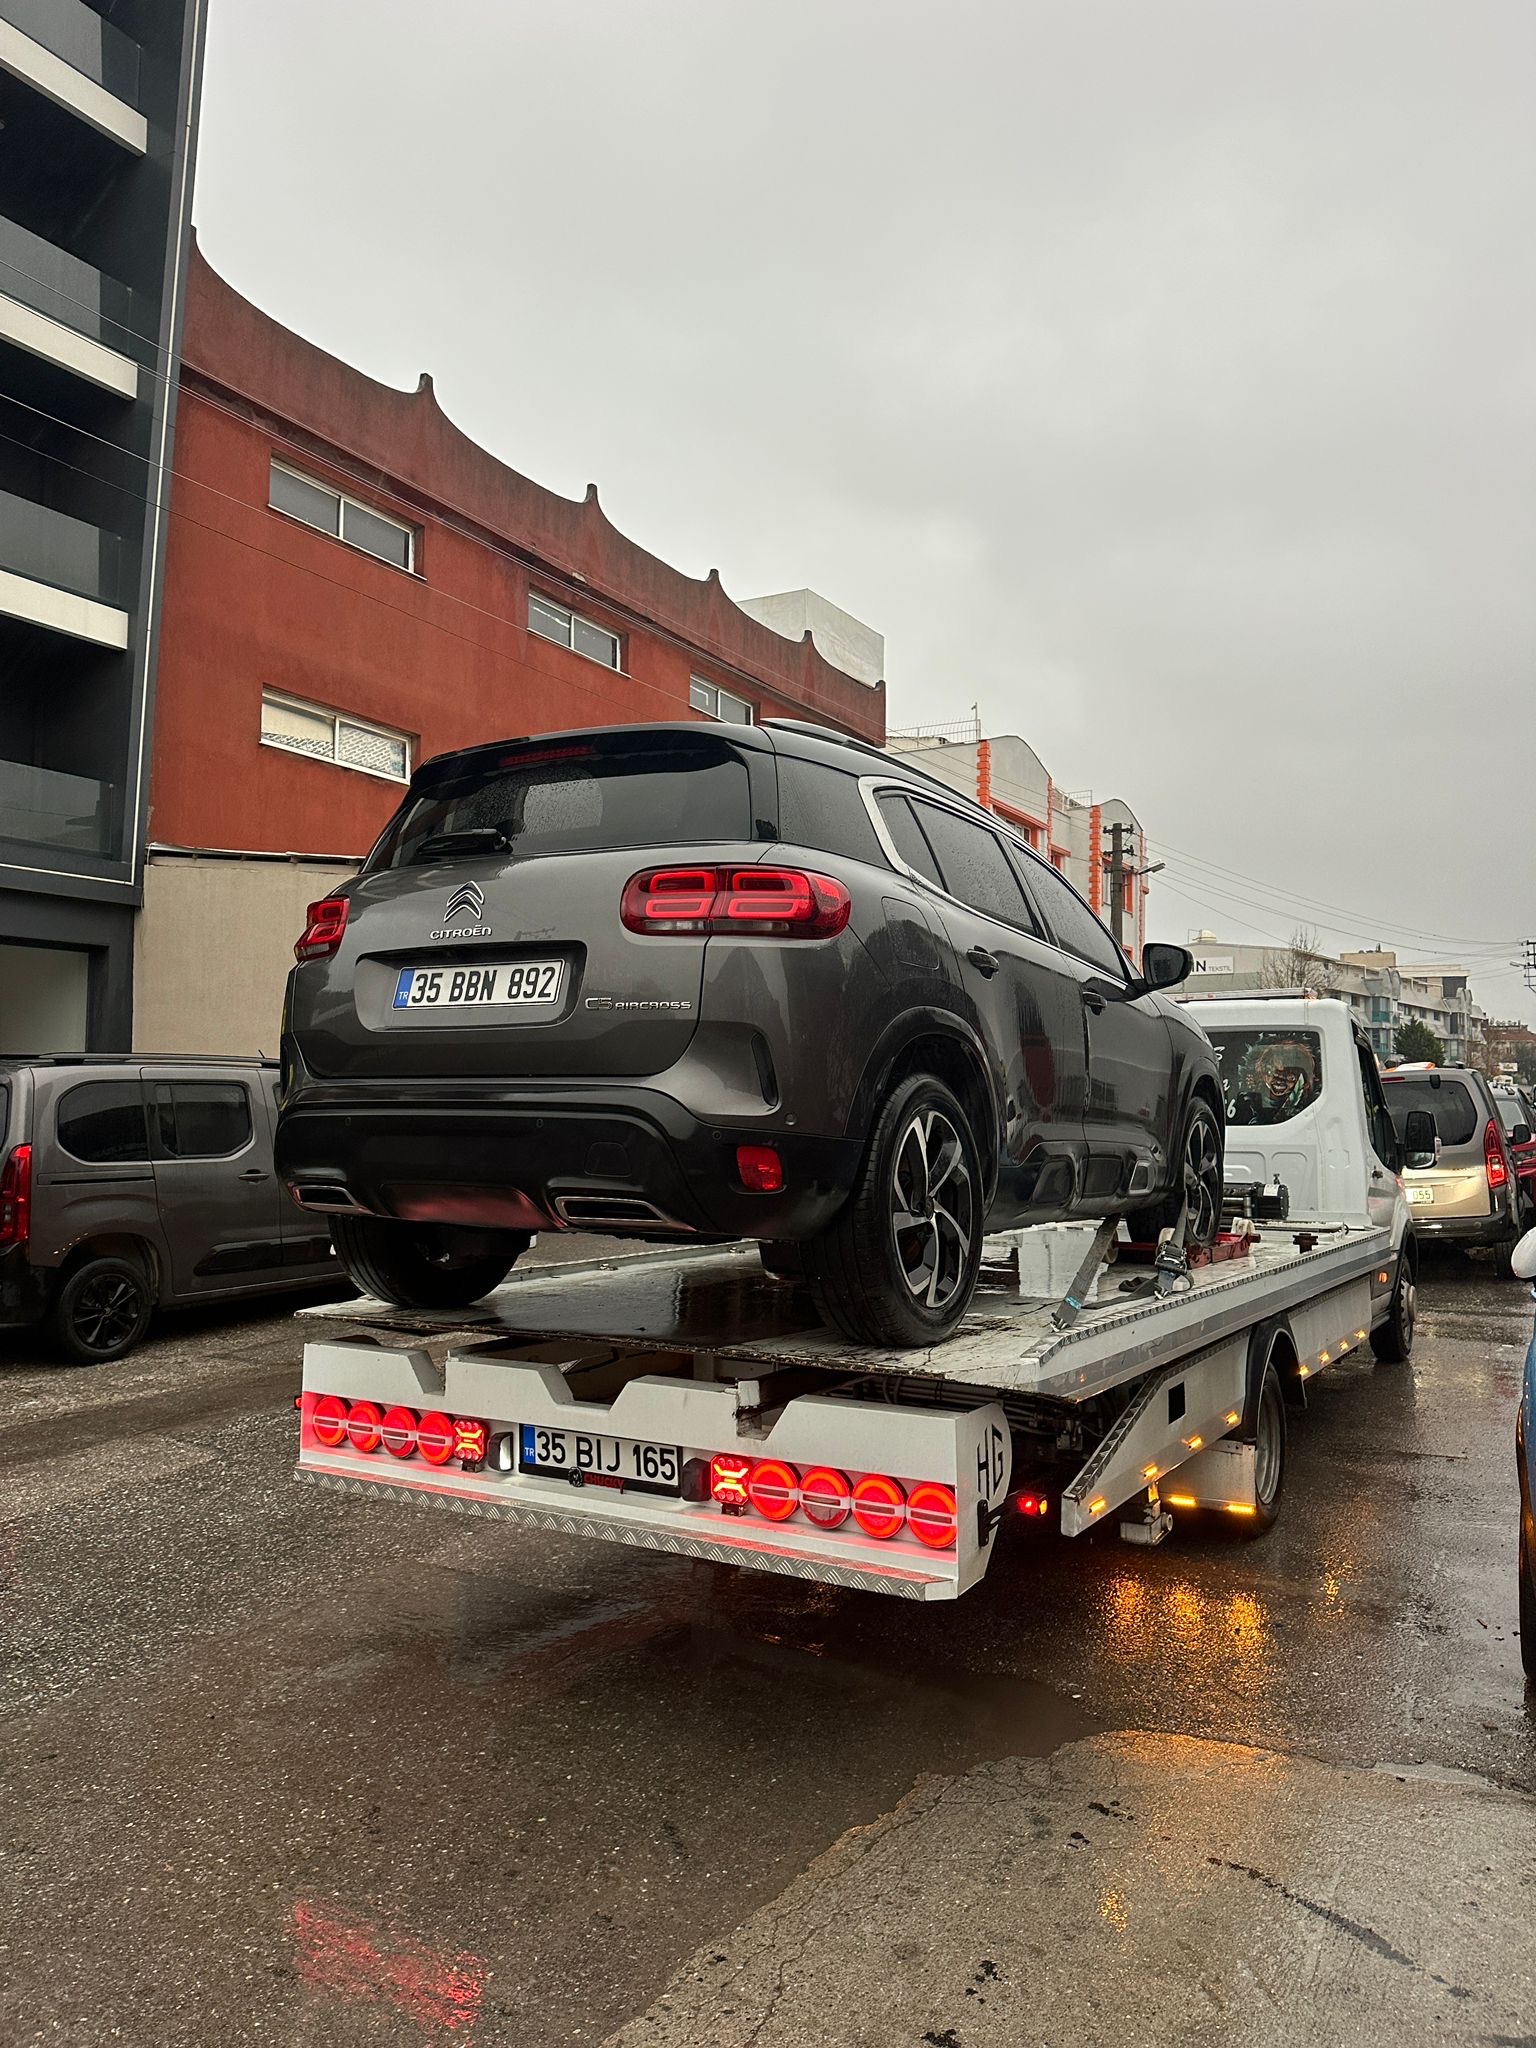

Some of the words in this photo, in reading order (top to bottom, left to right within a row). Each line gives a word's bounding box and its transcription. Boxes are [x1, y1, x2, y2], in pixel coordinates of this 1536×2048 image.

[398, 991, 409, 1000] TR
[411, 972, 443, 1003] 35
[449, 969, 498, 1003] BBN
[507, 966, 556, 1000] 892
[585, 997, 613, 1010] C5
[615, 1001, 692, 1010] AIRCROSS
[524, 1447, 534, 1456] TR
[536, 1430, 566, 1464] 35
[575, 1435, 621, 1472] BIJ
[633, 1444, 676, 1481] 165
[976, 1423, 1004, 1501] HG
[583, 1471, 625, 1495] CHUCKY
